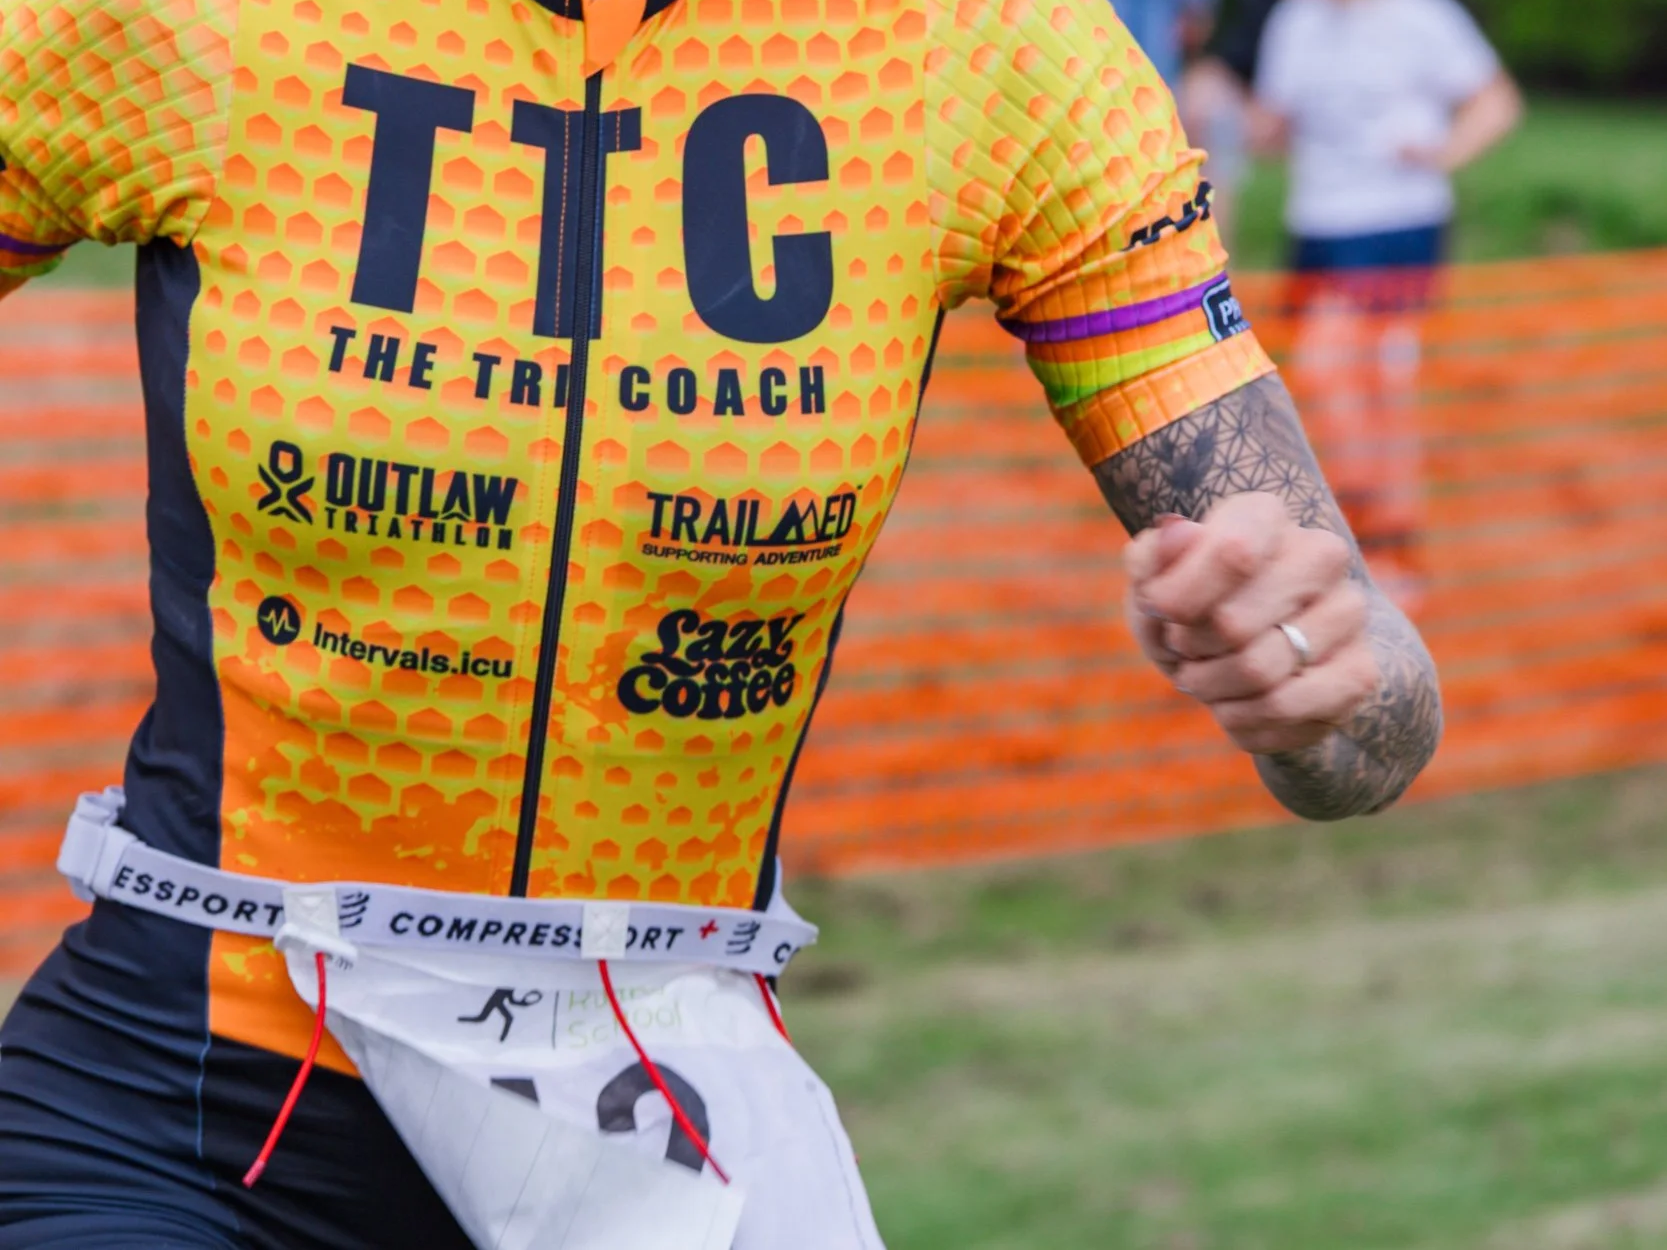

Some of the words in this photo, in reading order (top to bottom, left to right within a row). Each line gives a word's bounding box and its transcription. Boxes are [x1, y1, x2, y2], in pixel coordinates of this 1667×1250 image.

[342, 62, 834, 344] TTC
[328, 325, 437, 390] THE
[472, 352, 573, 409] TRI
[619, 365, 825, 417] COACH
[325, 452, 519, 526] OUTLAW
[325, 507, 513, 550] TRIATHLON
[642, 543, 748, 566] SUPPORTING
[754, 544, 843, 566] ADVENTURE
[313, 623, 513, 678] Intervals.icu
[640, 609, 806, 677] Lazy
[617, 660, 796, 720] Coffee
